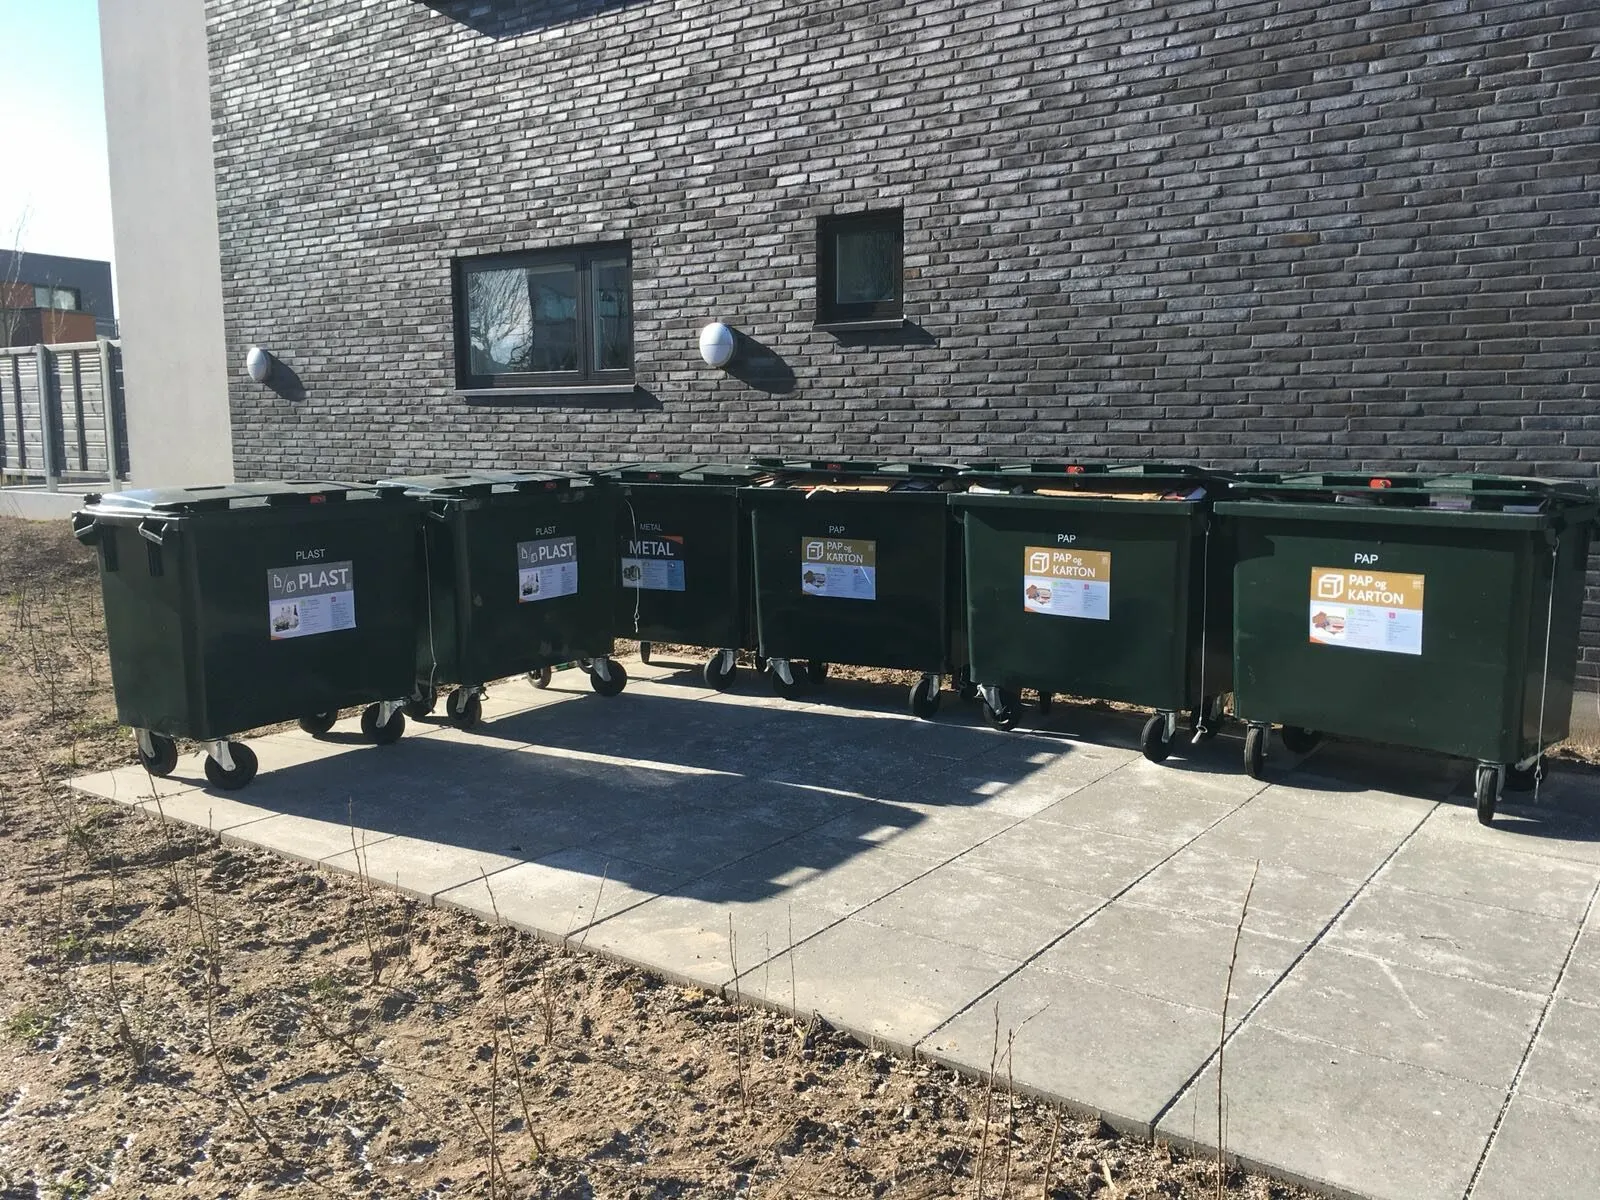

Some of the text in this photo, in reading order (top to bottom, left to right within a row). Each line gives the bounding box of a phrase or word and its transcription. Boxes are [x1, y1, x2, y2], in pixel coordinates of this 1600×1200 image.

[536, 526, 556, 535] PLAST
[640, 523, 662, 531] METAL
[829, 526, 845, 534] PAP
[1057, 534, 1076, 543] PAP
[539, 543, 574, 560] PLAST
[629, 540, 674, 556] METAL
[826, 541, 852, 553] PAP og
[296, 549, 325, 560] PLAST
[826, 553, 864, 563] KARTON
[1053, 552, 1082, 566] PAP og
[1354, 553, 1378, 564] PAP
[1052, 565, 1096, 577] KARTON
[298, 568, 349, 590] PLAST
[1349, 574, 1387, 591] PAP og
[1348, 589, 1404, 605] KARTON
